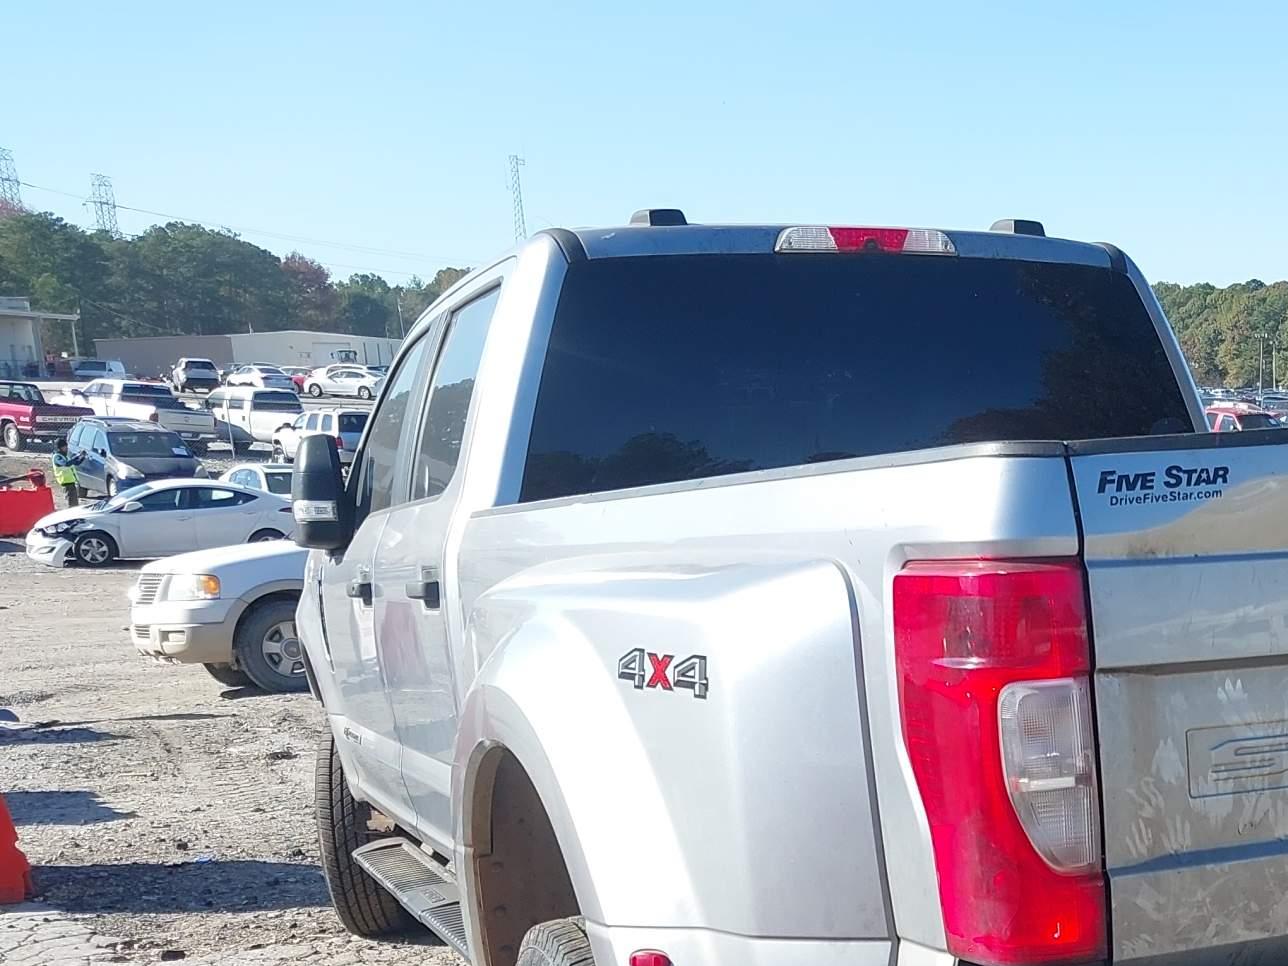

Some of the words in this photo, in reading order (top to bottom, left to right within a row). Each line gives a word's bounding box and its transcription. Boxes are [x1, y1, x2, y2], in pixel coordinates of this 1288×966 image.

[1097, 470, 1156, 494] FIVE
[1163, 465, 1230, 489] STAR
[1110, 489, 1223, 506] DriveFiveStar.com
